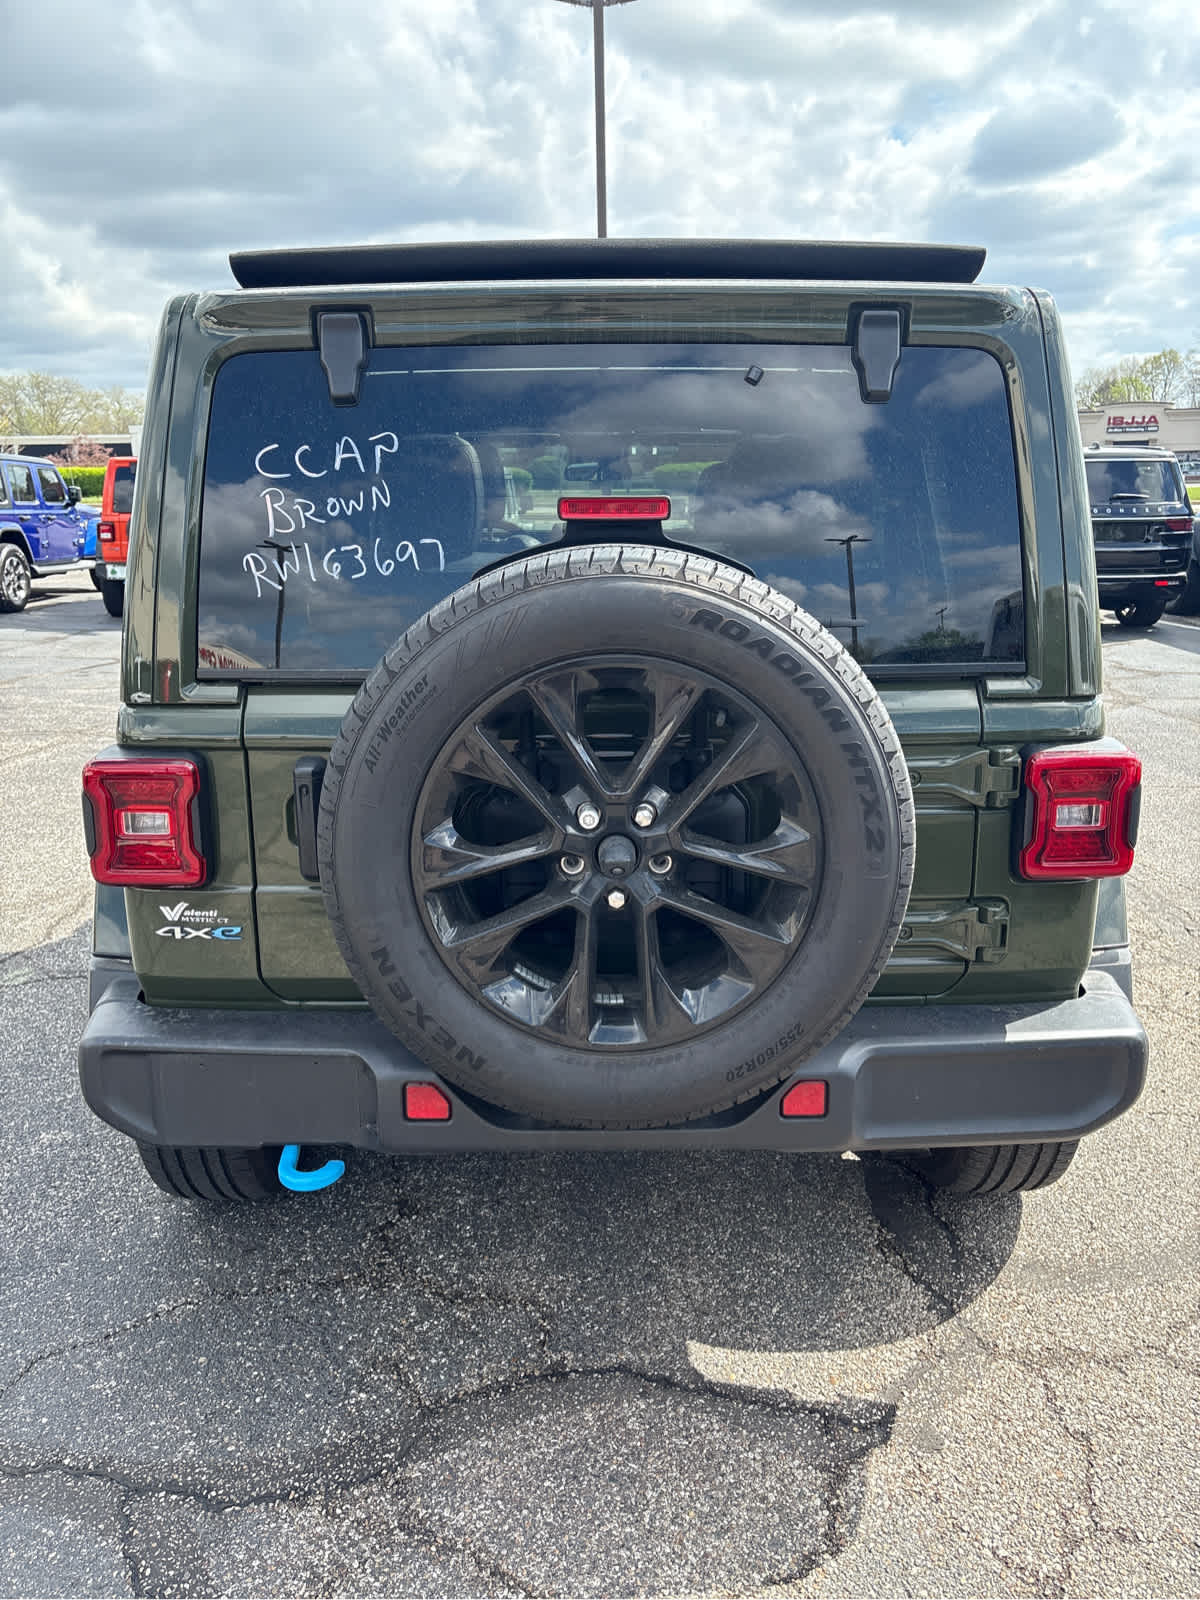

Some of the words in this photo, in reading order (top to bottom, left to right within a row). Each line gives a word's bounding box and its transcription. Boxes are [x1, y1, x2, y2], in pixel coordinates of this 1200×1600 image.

[1107, 415, 1159, 426] IBJJA
[255, 431, 399, 479] CCAP
[259, 479, 391, 538] BROWN
[243, 537, 445, 598] RW163697
[688, 608, 852, 733] ROADIAN
[363, 673, 429, 775] All-Weather
[159, 901, 219, 921] Valenti
[371, 946, 486, 1071] NEXEN
